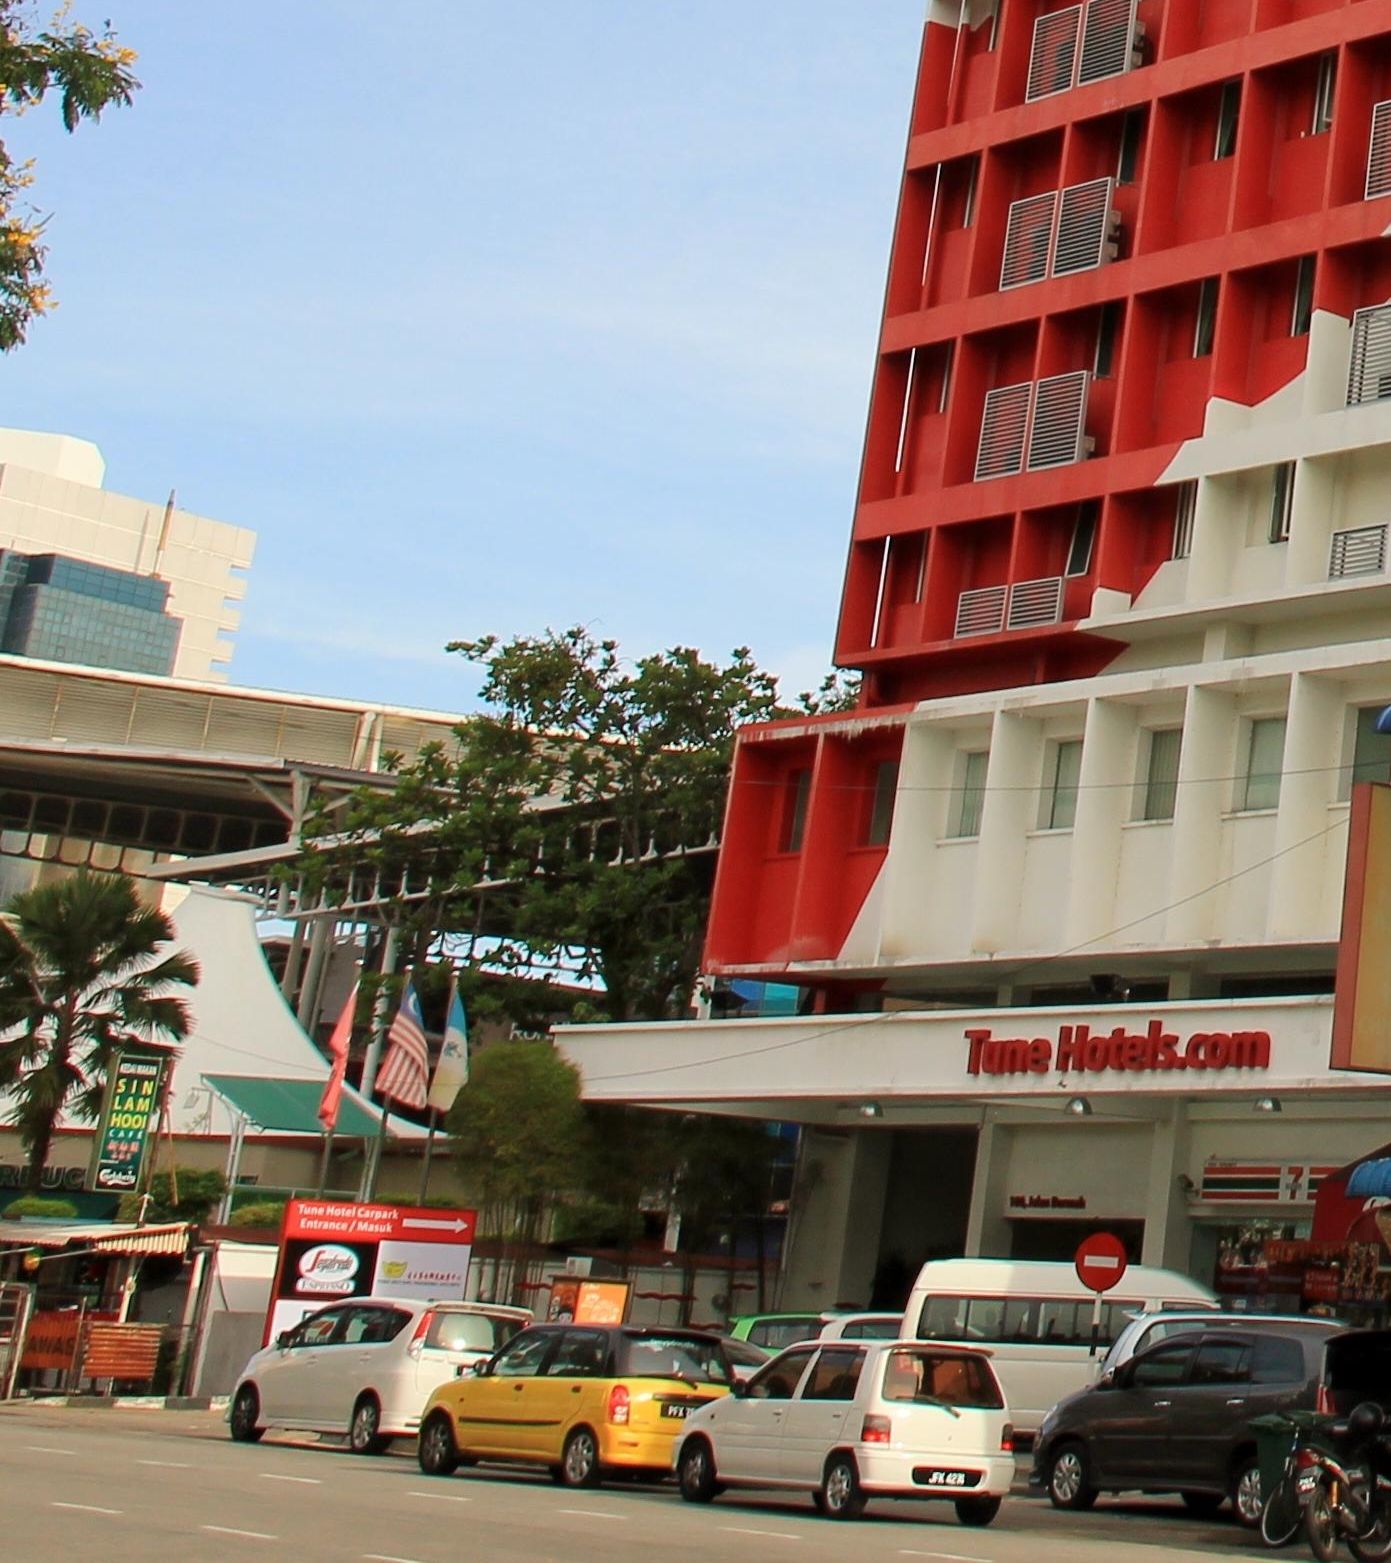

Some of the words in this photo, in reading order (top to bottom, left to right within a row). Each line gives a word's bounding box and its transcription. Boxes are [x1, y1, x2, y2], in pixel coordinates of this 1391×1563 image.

[964, 1028, 1052, 1075] Tune
[1055, 1020, 1272, 1072] Hotels.com
[116, 1078, 154, 1095] SIN
[113, 1096, 151, 1112] LAM
[110, 1112, 147, 1129] HOOI
[298, 1204, 325, 1216] Tune
[326, 1205, 356, 1217] Hotel
[357, 1207, 400, 1221] Carpark
[300, 1218, 348, 1231] Entrance
[357, 1221, 393, 1233] Masuk
